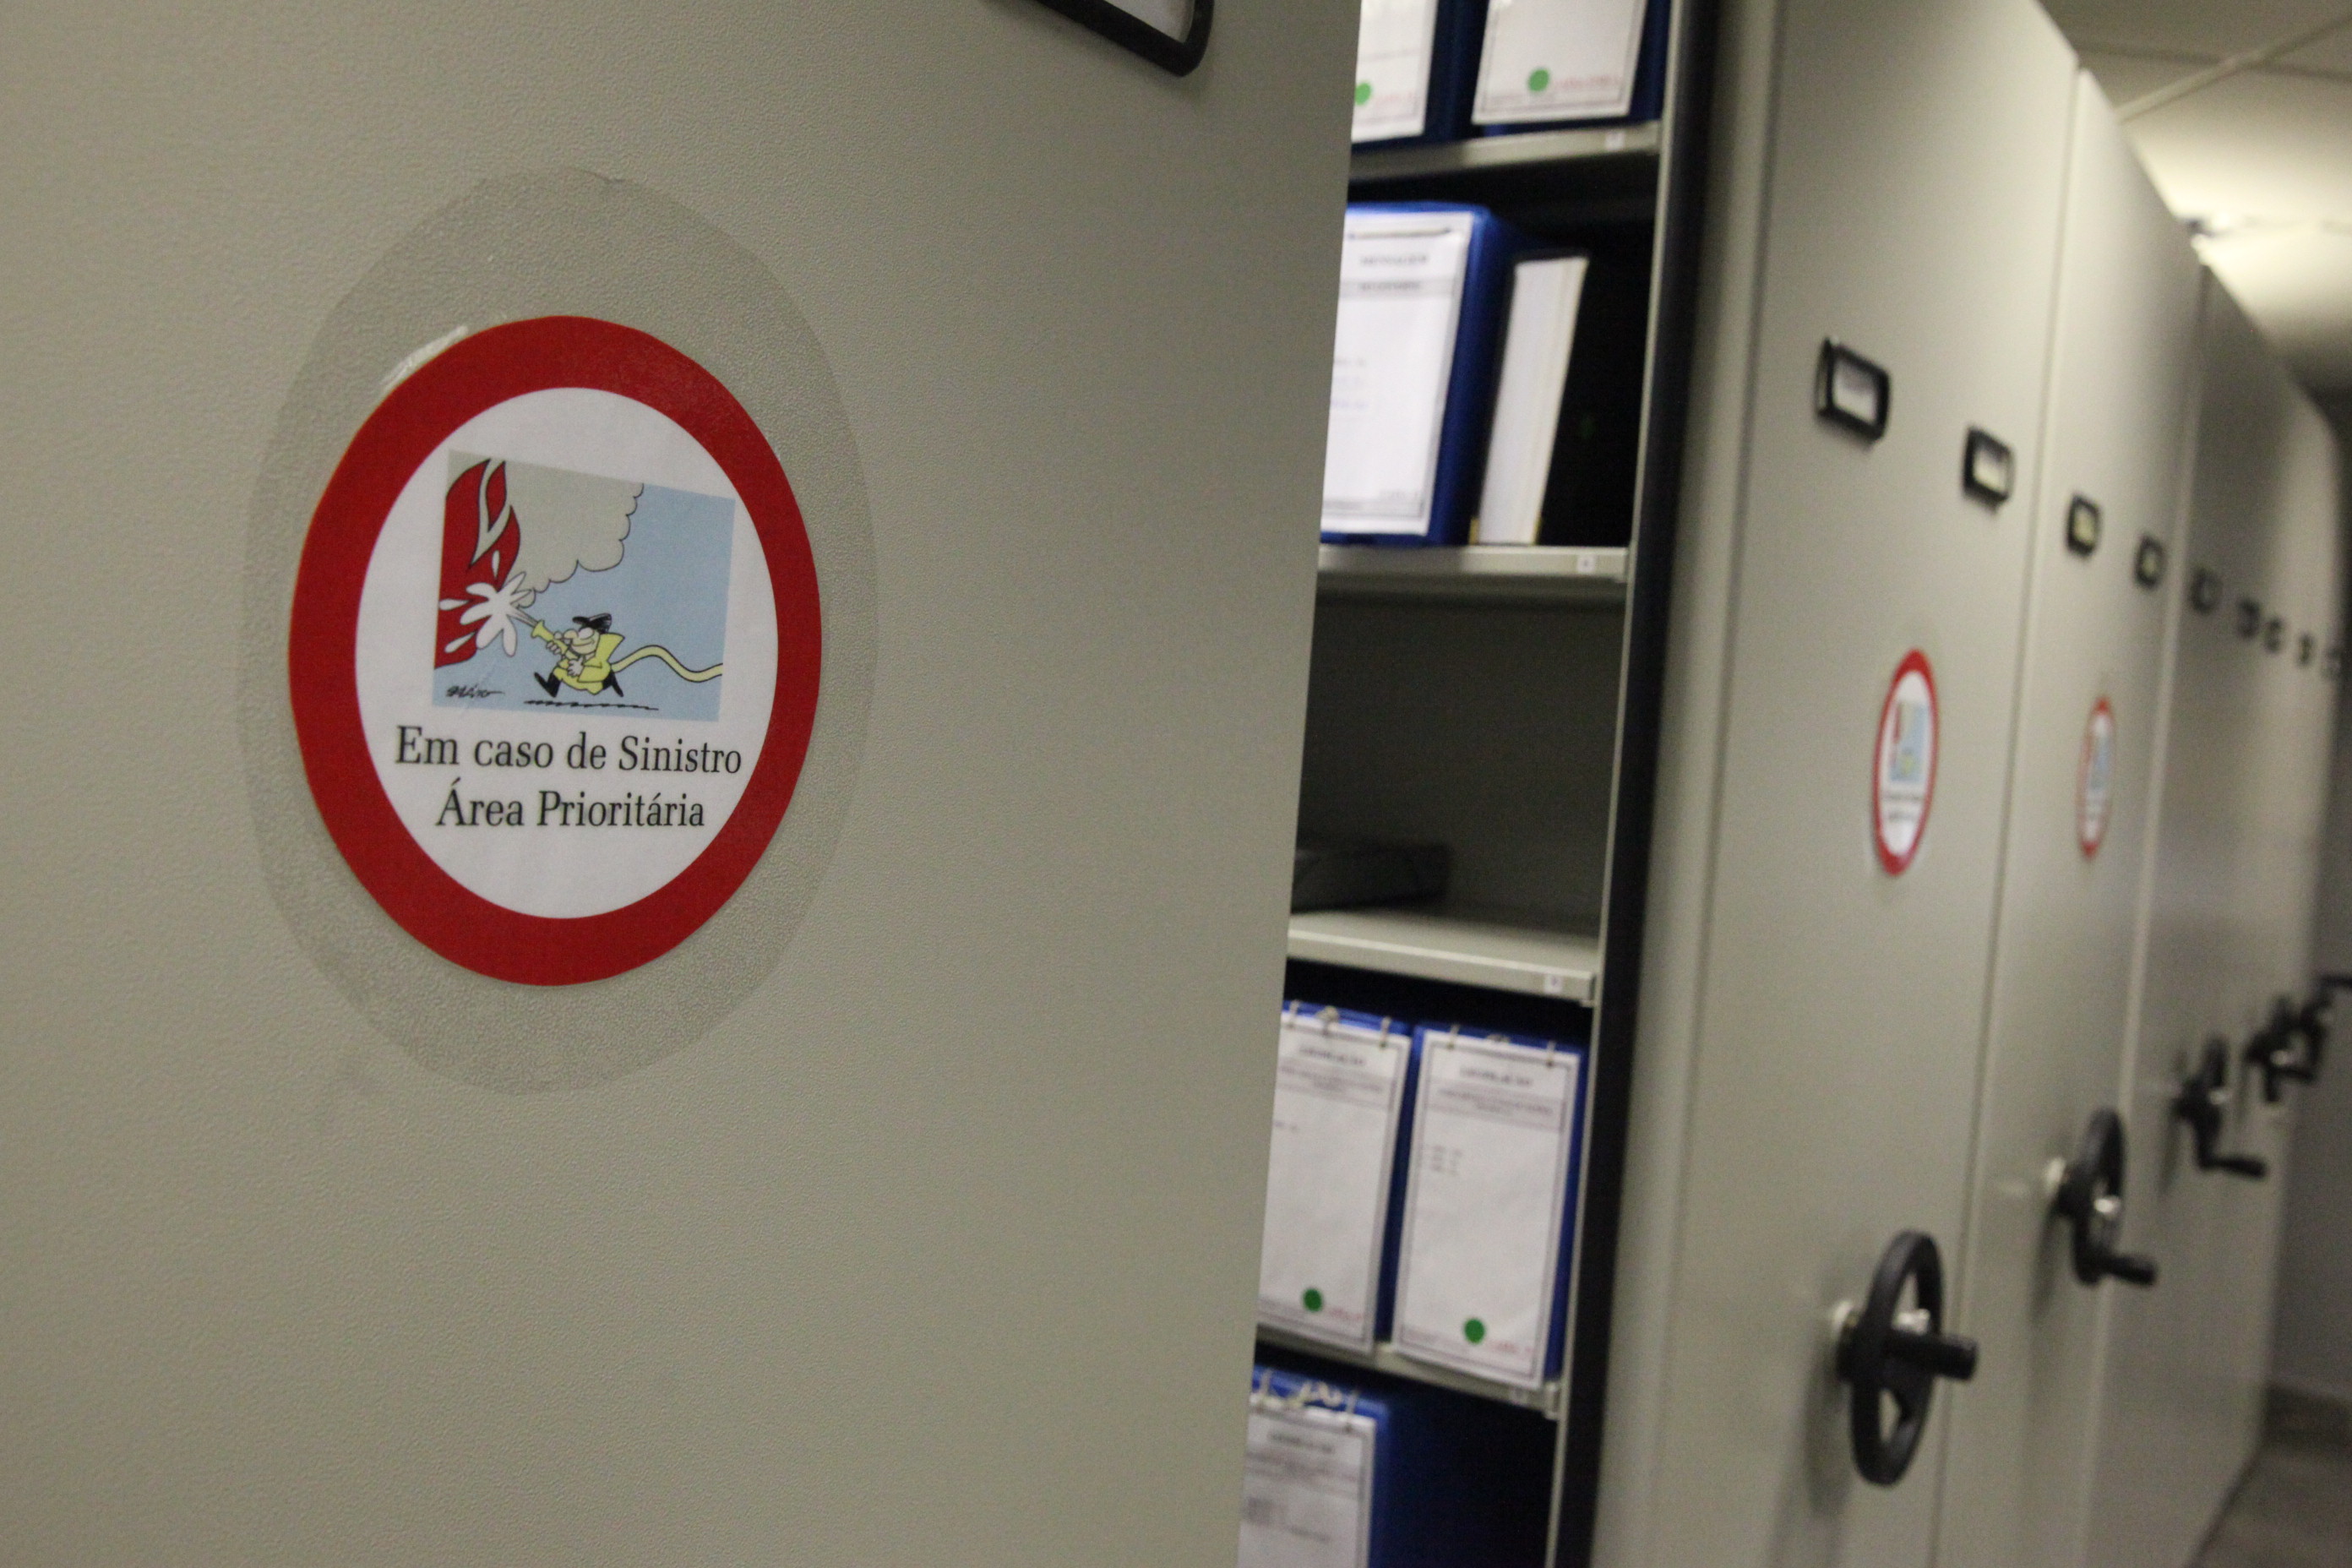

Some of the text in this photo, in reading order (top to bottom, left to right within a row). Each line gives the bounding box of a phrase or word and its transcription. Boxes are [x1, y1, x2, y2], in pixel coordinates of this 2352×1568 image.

[395, 724, 742, 775] Em caso de Sinistro
[435, 776, 705, 827] Área Prioritária
